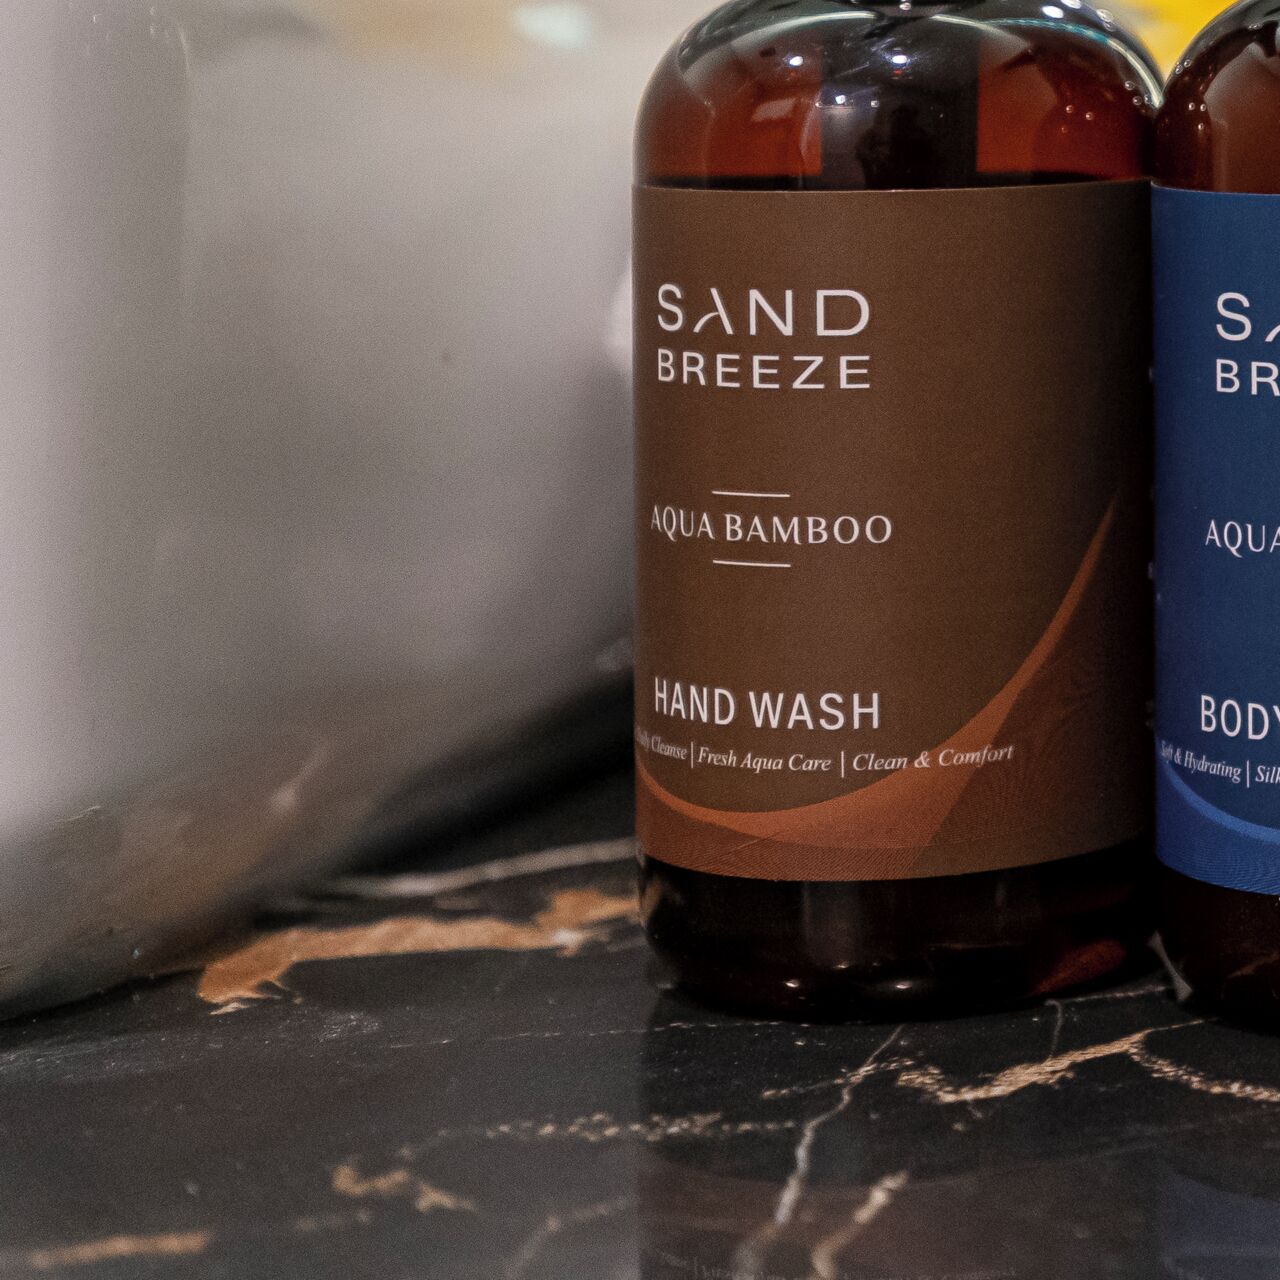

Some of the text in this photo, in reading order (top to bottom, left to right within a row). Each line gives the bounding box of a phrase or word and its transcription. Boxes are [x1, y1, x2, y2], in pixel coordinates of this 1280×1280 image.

[656, 283, 872, 338] SAND
[656, 347, 872, 390] BREEZE
[649, 503, 893, 547] AQUA BAMBOO
[654, 676, 881, 731] HAND WASH
[650, 735, 688, 760] Cleanse
[697, 746, 738, 768] Fresh
[740, 751, 783, 774] Aqua
[787, 753, 832, 772] Care
[852, 752, 908, 772] Clean
[913, 750, 931, 769] &
[938, 744, 1015, 768] Comfort
[1184, 749, 1242, 784] Hydrating
